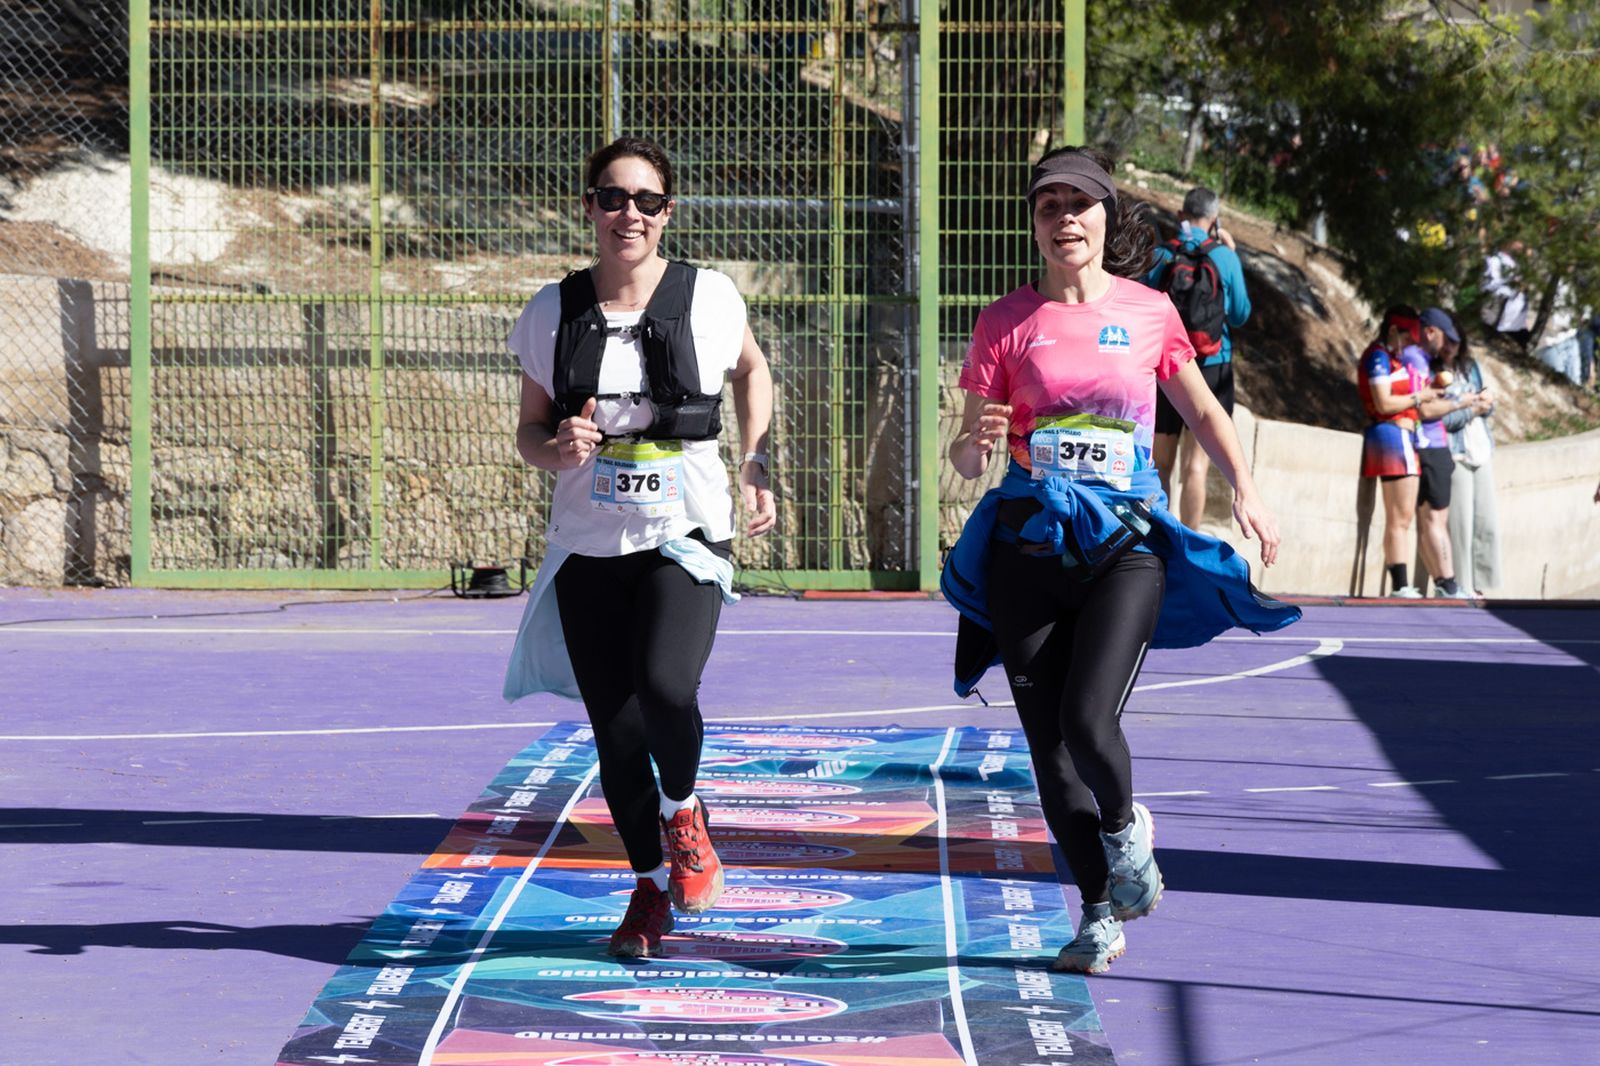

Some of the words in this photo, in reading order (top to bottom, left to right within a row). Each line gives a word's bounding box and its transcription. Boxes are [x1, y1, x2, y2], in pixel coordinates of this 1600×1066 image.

[1060, 441, 1107, 462] 375
[616, 473, 660, 493] 376
[564, 915, 883, 925] #somoselcbio
[514, 1031, 888, 1043] #somoselcambio
